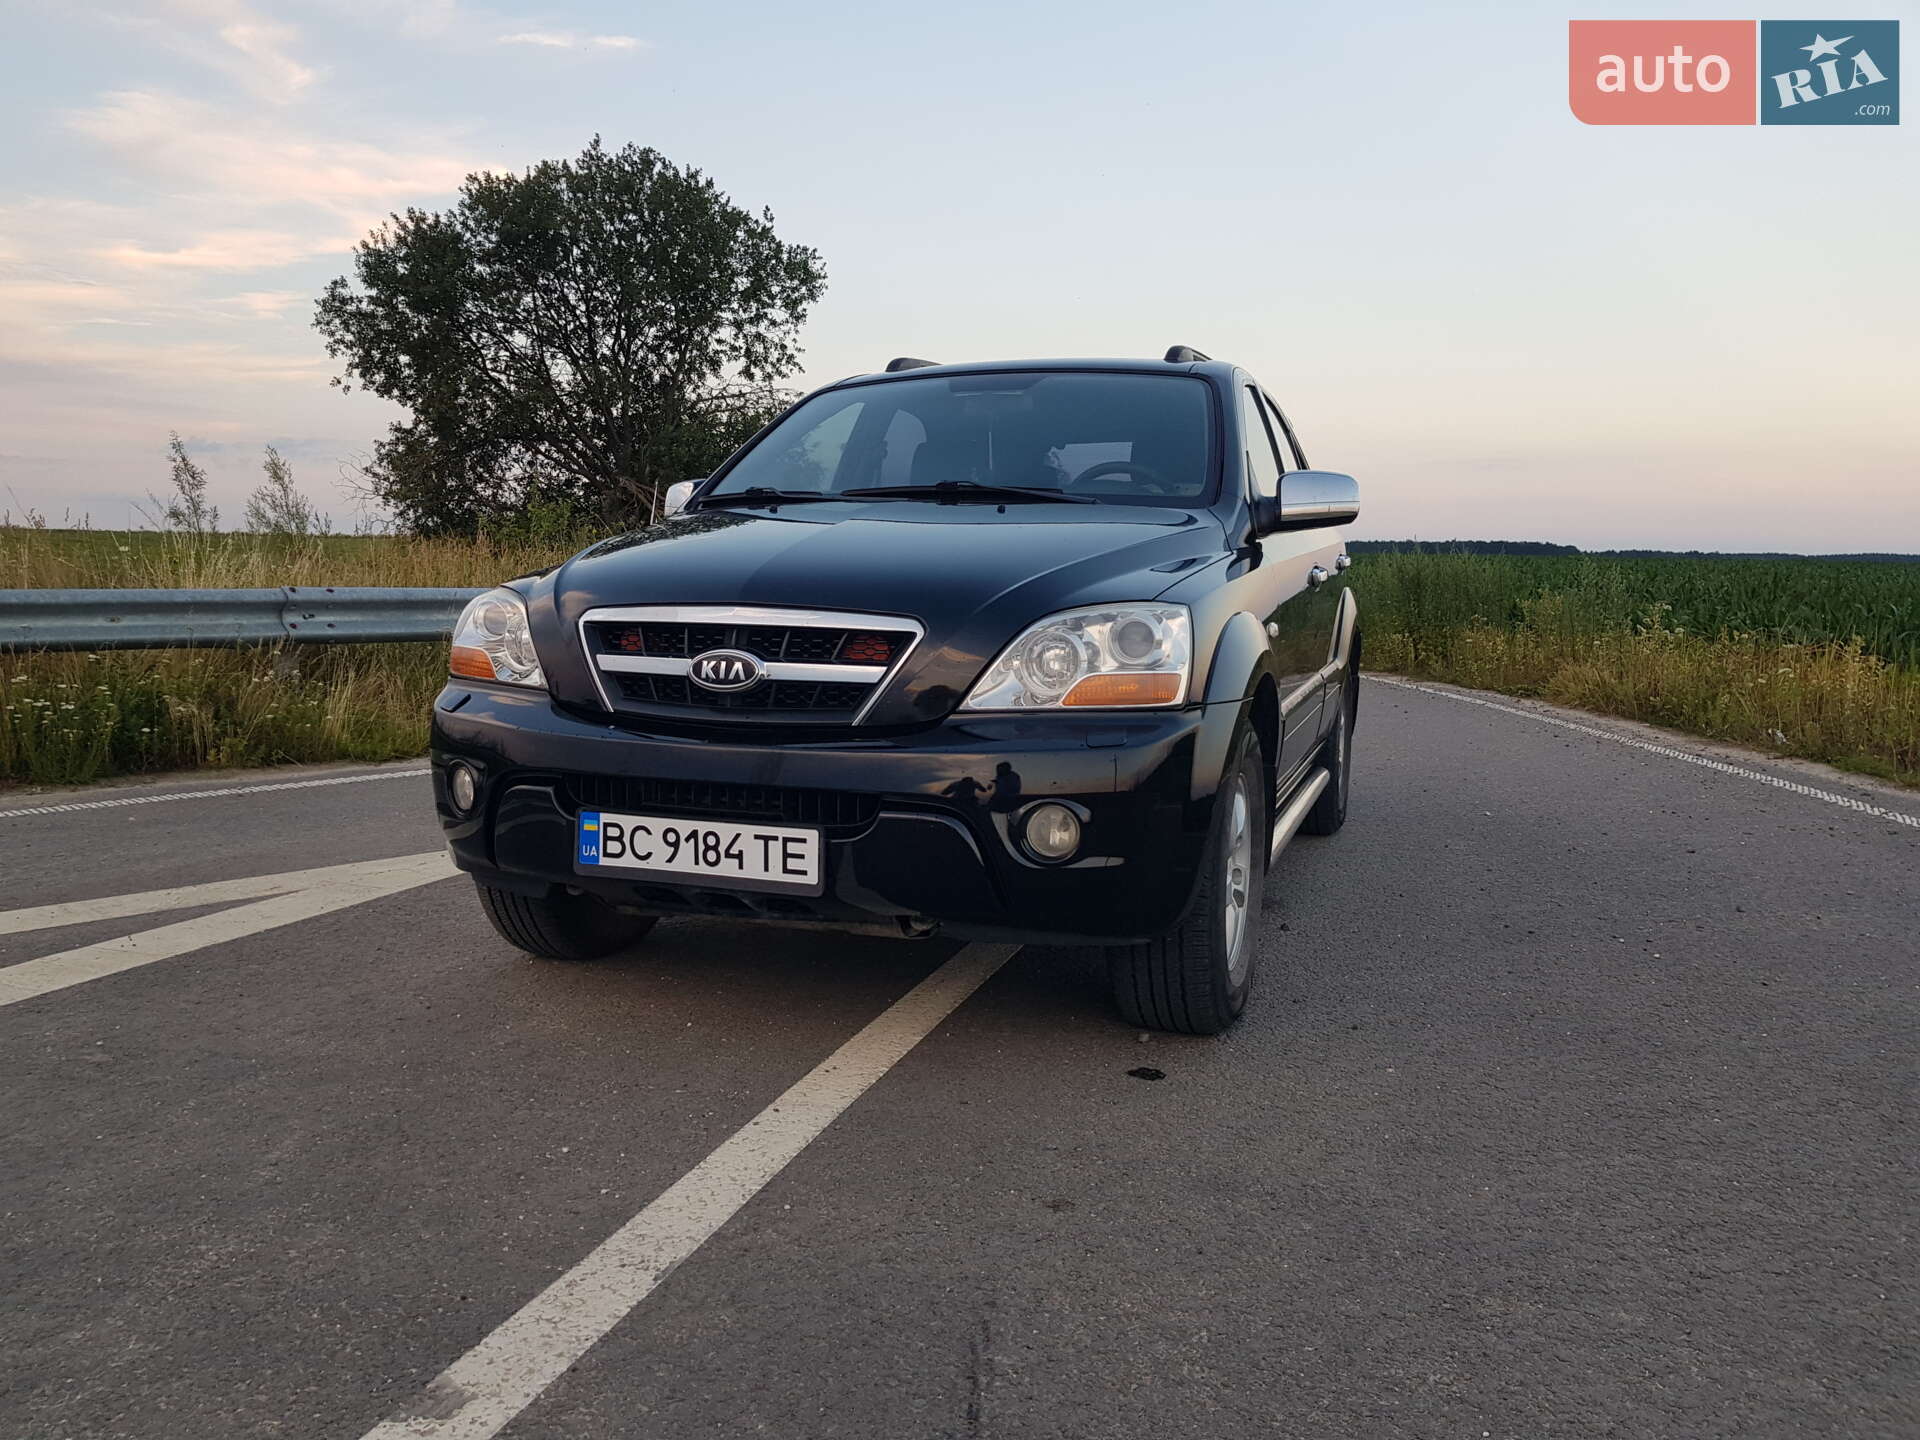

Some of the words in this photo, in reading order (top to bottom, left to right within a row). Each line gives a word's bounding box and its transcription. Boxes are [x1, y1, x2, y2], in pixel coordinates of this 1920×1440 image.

[701, 660, 746, 681] KIA
[582, 845, 598, 857] UA
[602, 822, 653, 861] BC
[662, 827, 744, 870] 9184
[753, 834, 808, 876] TE
